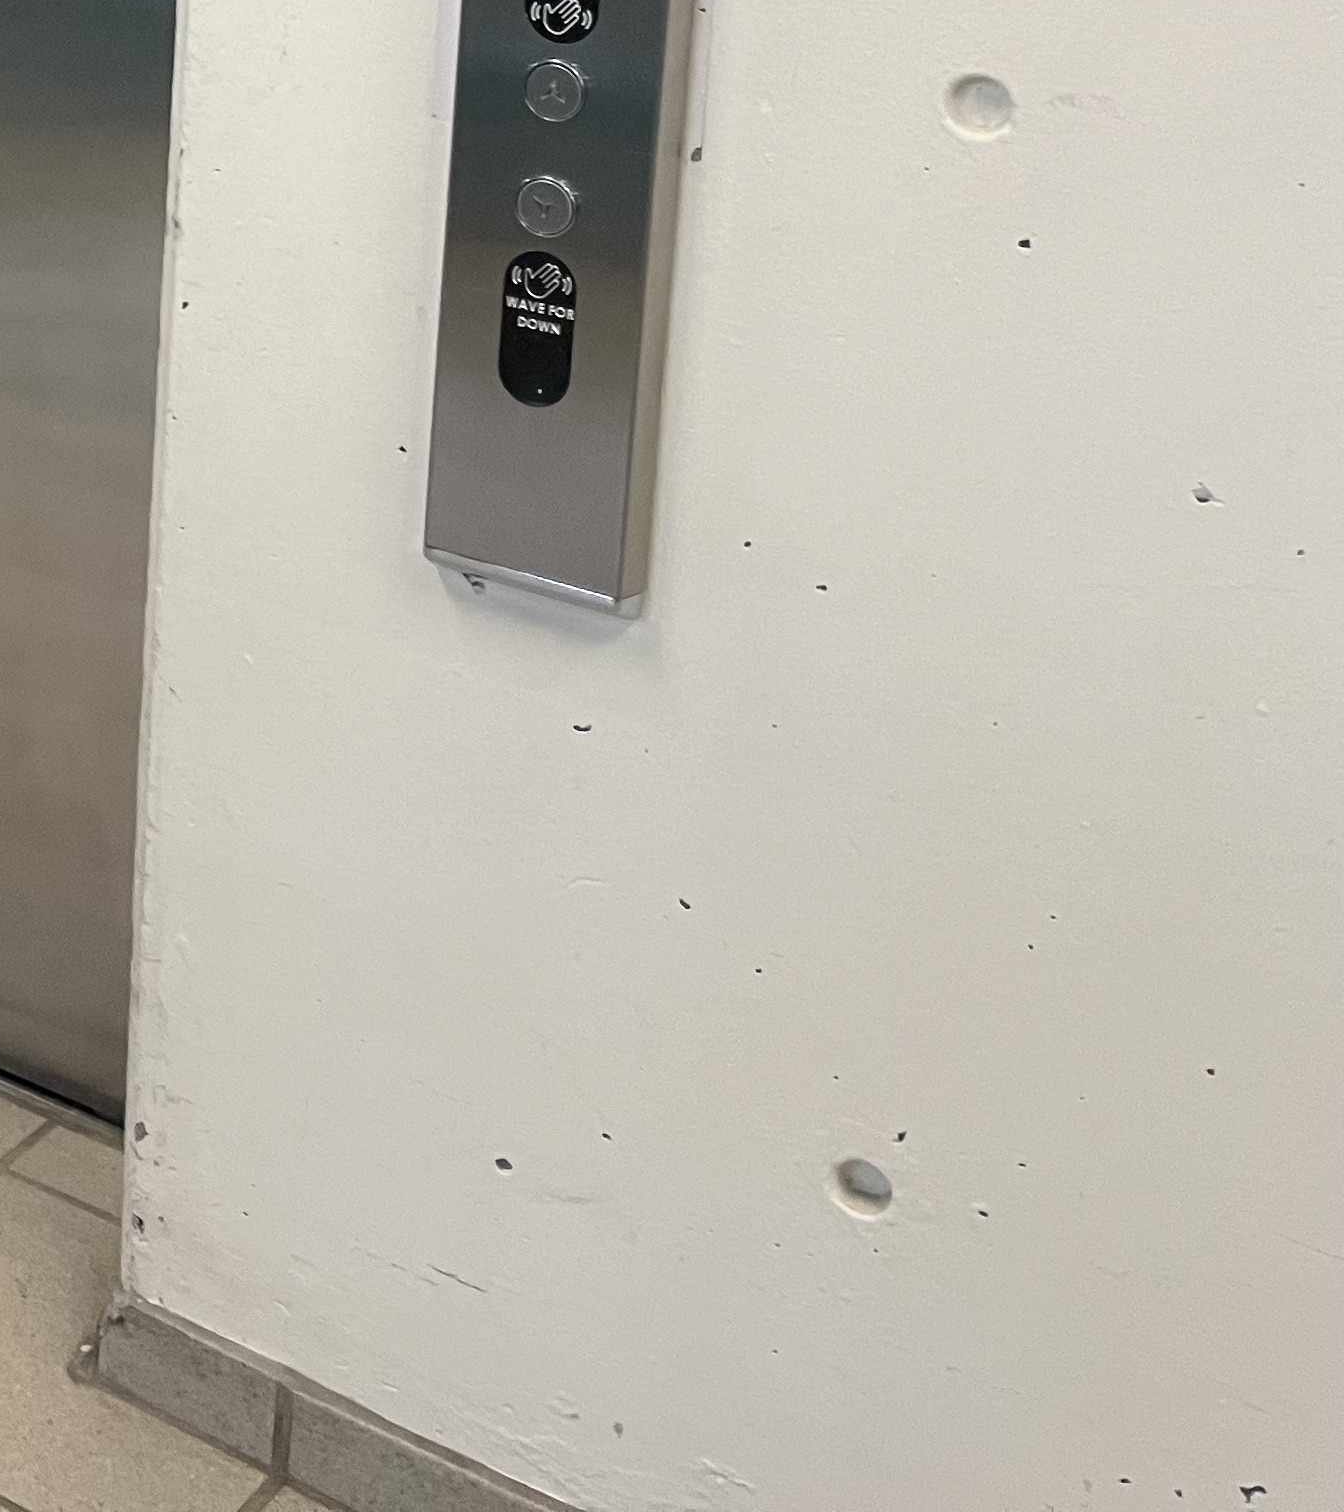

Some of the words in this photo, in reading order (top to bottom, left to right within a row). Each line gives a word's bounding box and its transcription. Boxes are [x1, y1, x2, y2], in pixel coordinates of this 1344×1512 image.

[505, 295, 546, 315] WAVE
[548, 304, 575, 321] FOR
[517, 315, 561, 336] DOWN
